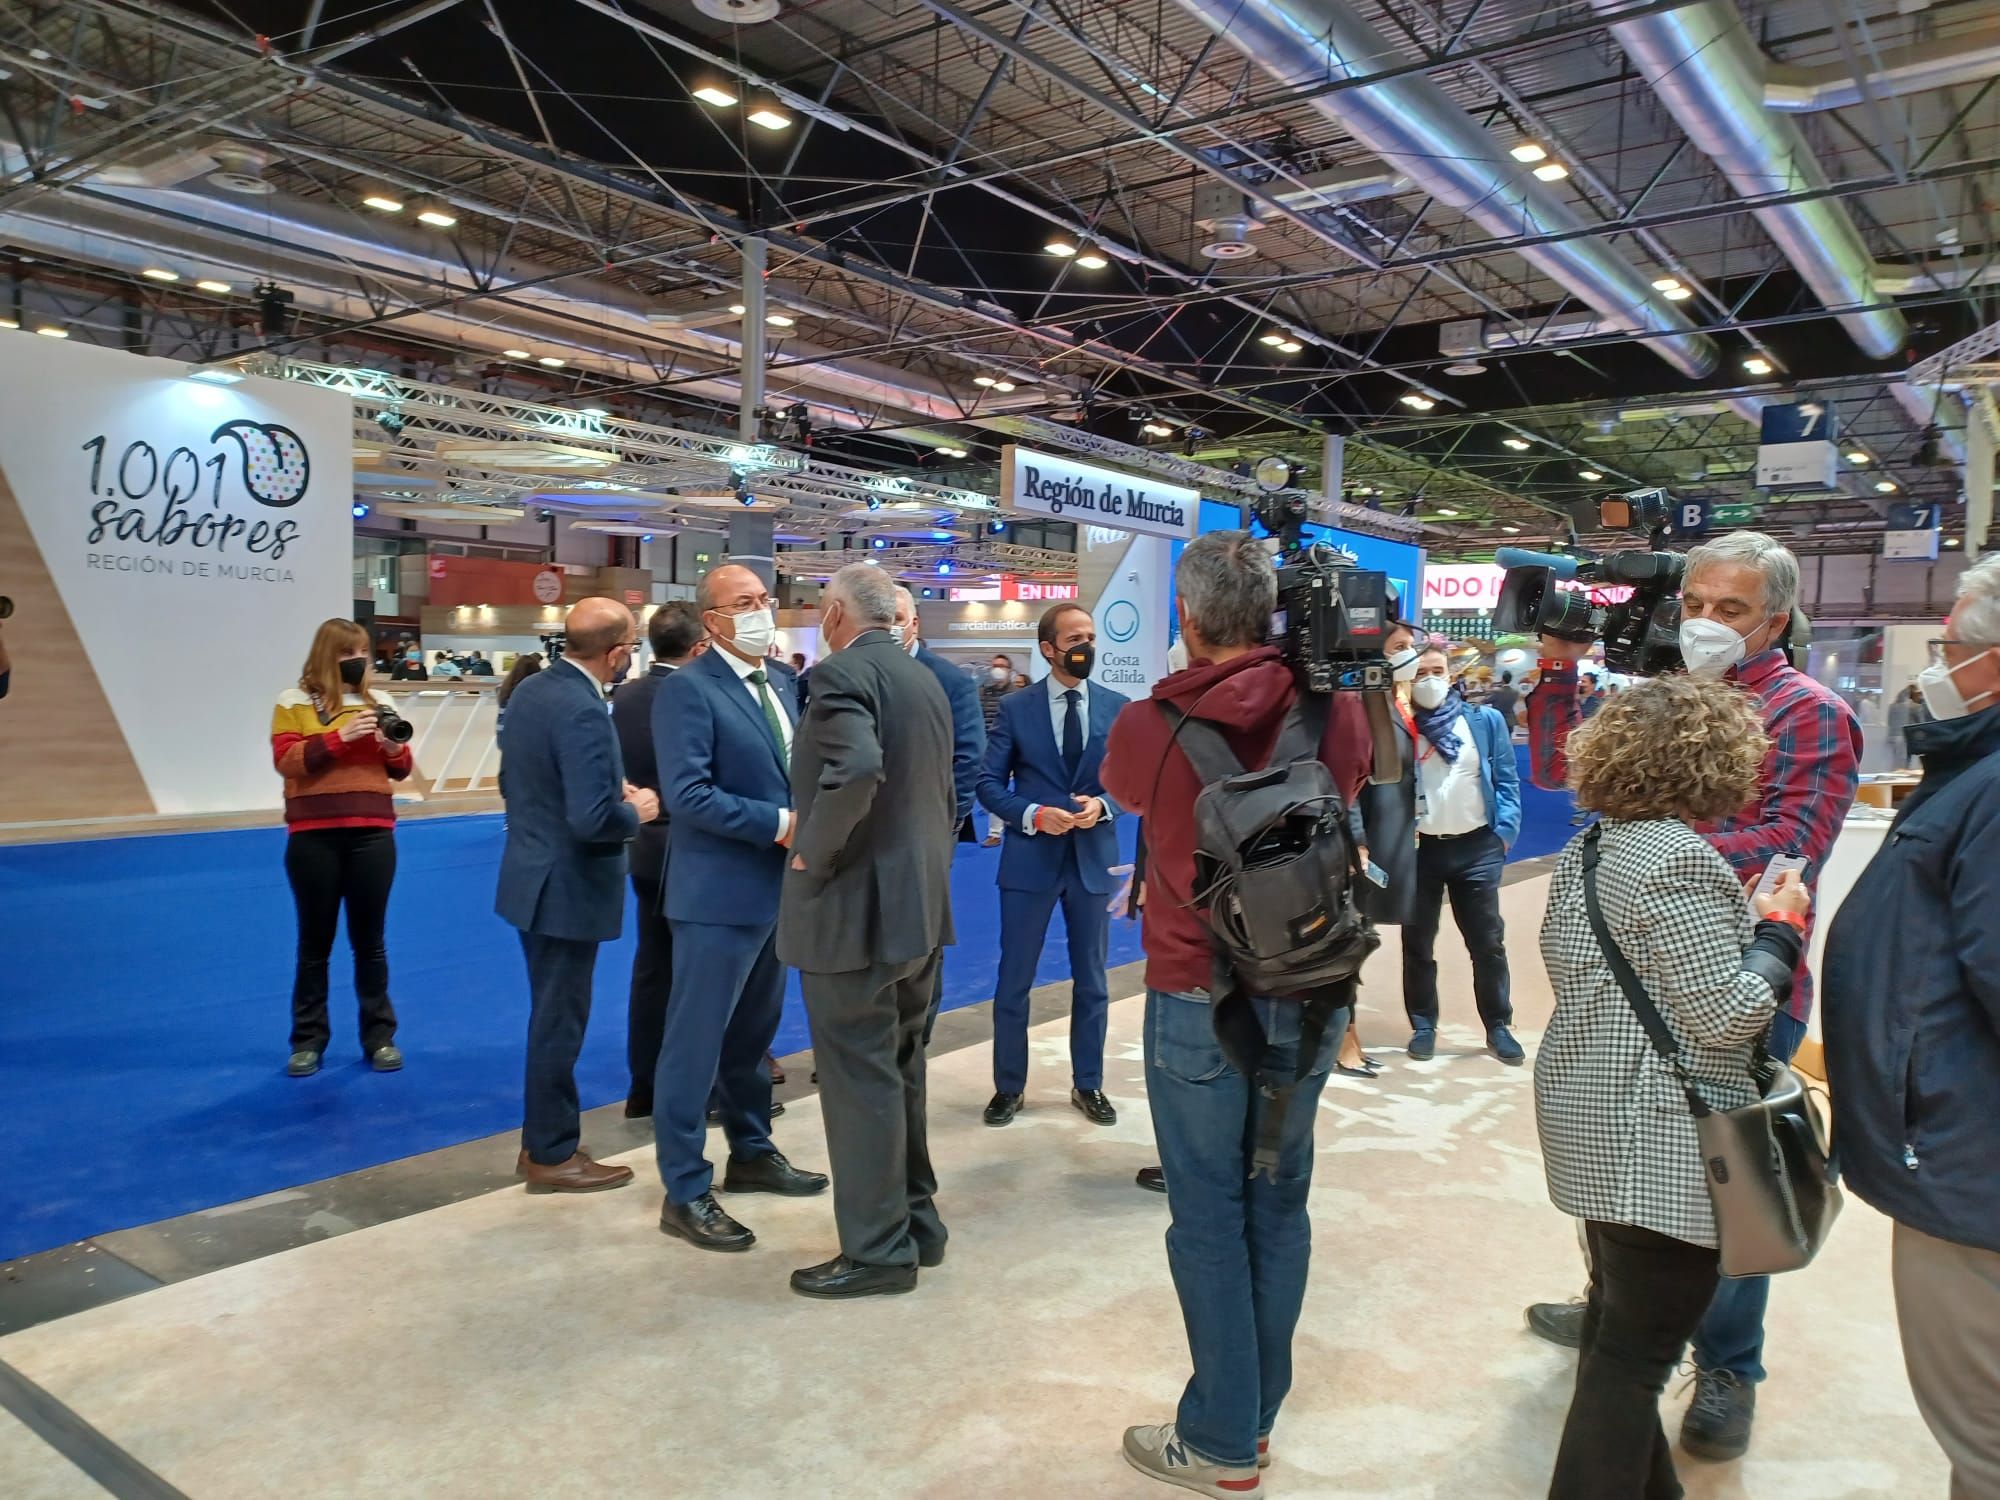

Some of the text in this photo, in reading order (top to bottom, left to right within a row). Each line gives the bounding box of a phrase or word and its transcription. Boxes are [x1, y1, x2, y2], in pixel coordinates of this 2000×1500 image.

[1798, 403, 1823, 437] 7
[82, 435, 226, 508] 1.001
[1023, 465, 1184, 527] Región de Murcia
[87, 485, 302, 560] sabores
[1682, 504, 1702, 527] B
[1912, 509, 1930, 527] 7
[86, 553, 295, 583] REGIÓN DE MURCIA
[1102, 652, 1140, 666] Costa
[1101, 669, 1146, 683] Cálida
